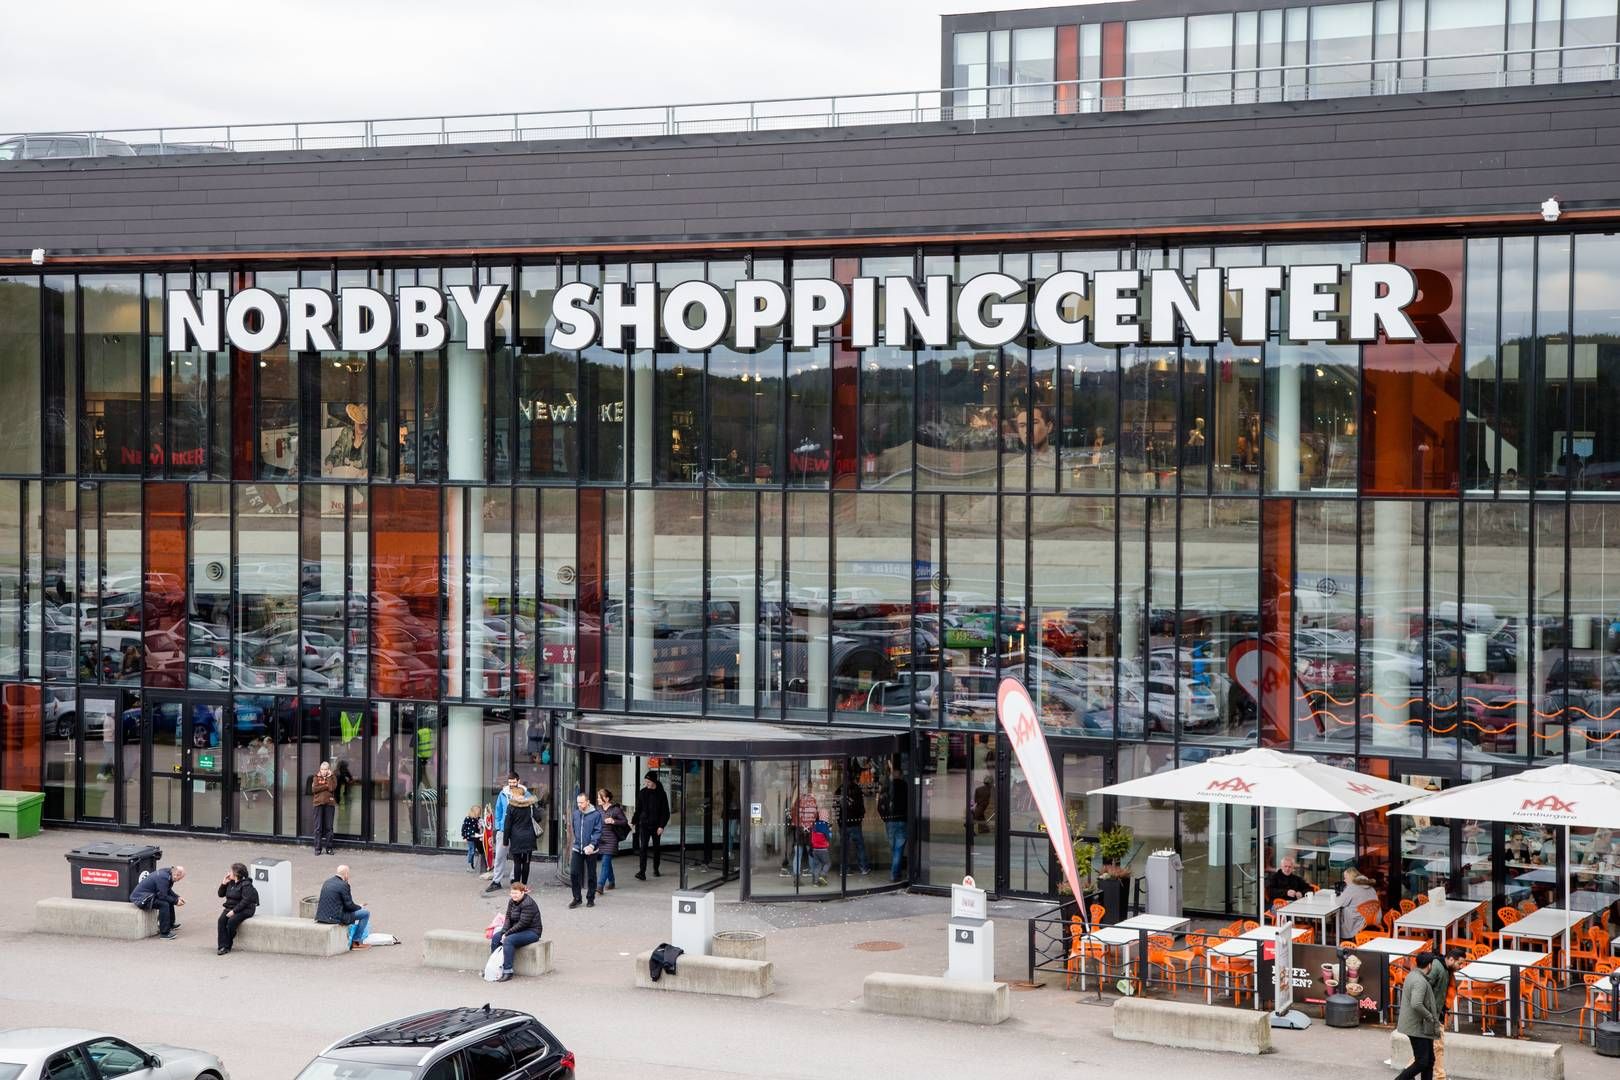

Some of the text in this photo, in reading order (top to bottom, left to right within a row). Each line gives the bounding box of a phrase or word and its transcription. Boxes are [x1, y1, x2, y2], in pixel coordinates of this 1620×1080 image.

[168, 263, 1419, 352] NORDBY SHOPPINGCENTER
[1207, 777, 1257, 792] MAX
[1521, 795, 1579, 812] MAX
[1359, 996, 1378, 1010] MAX
